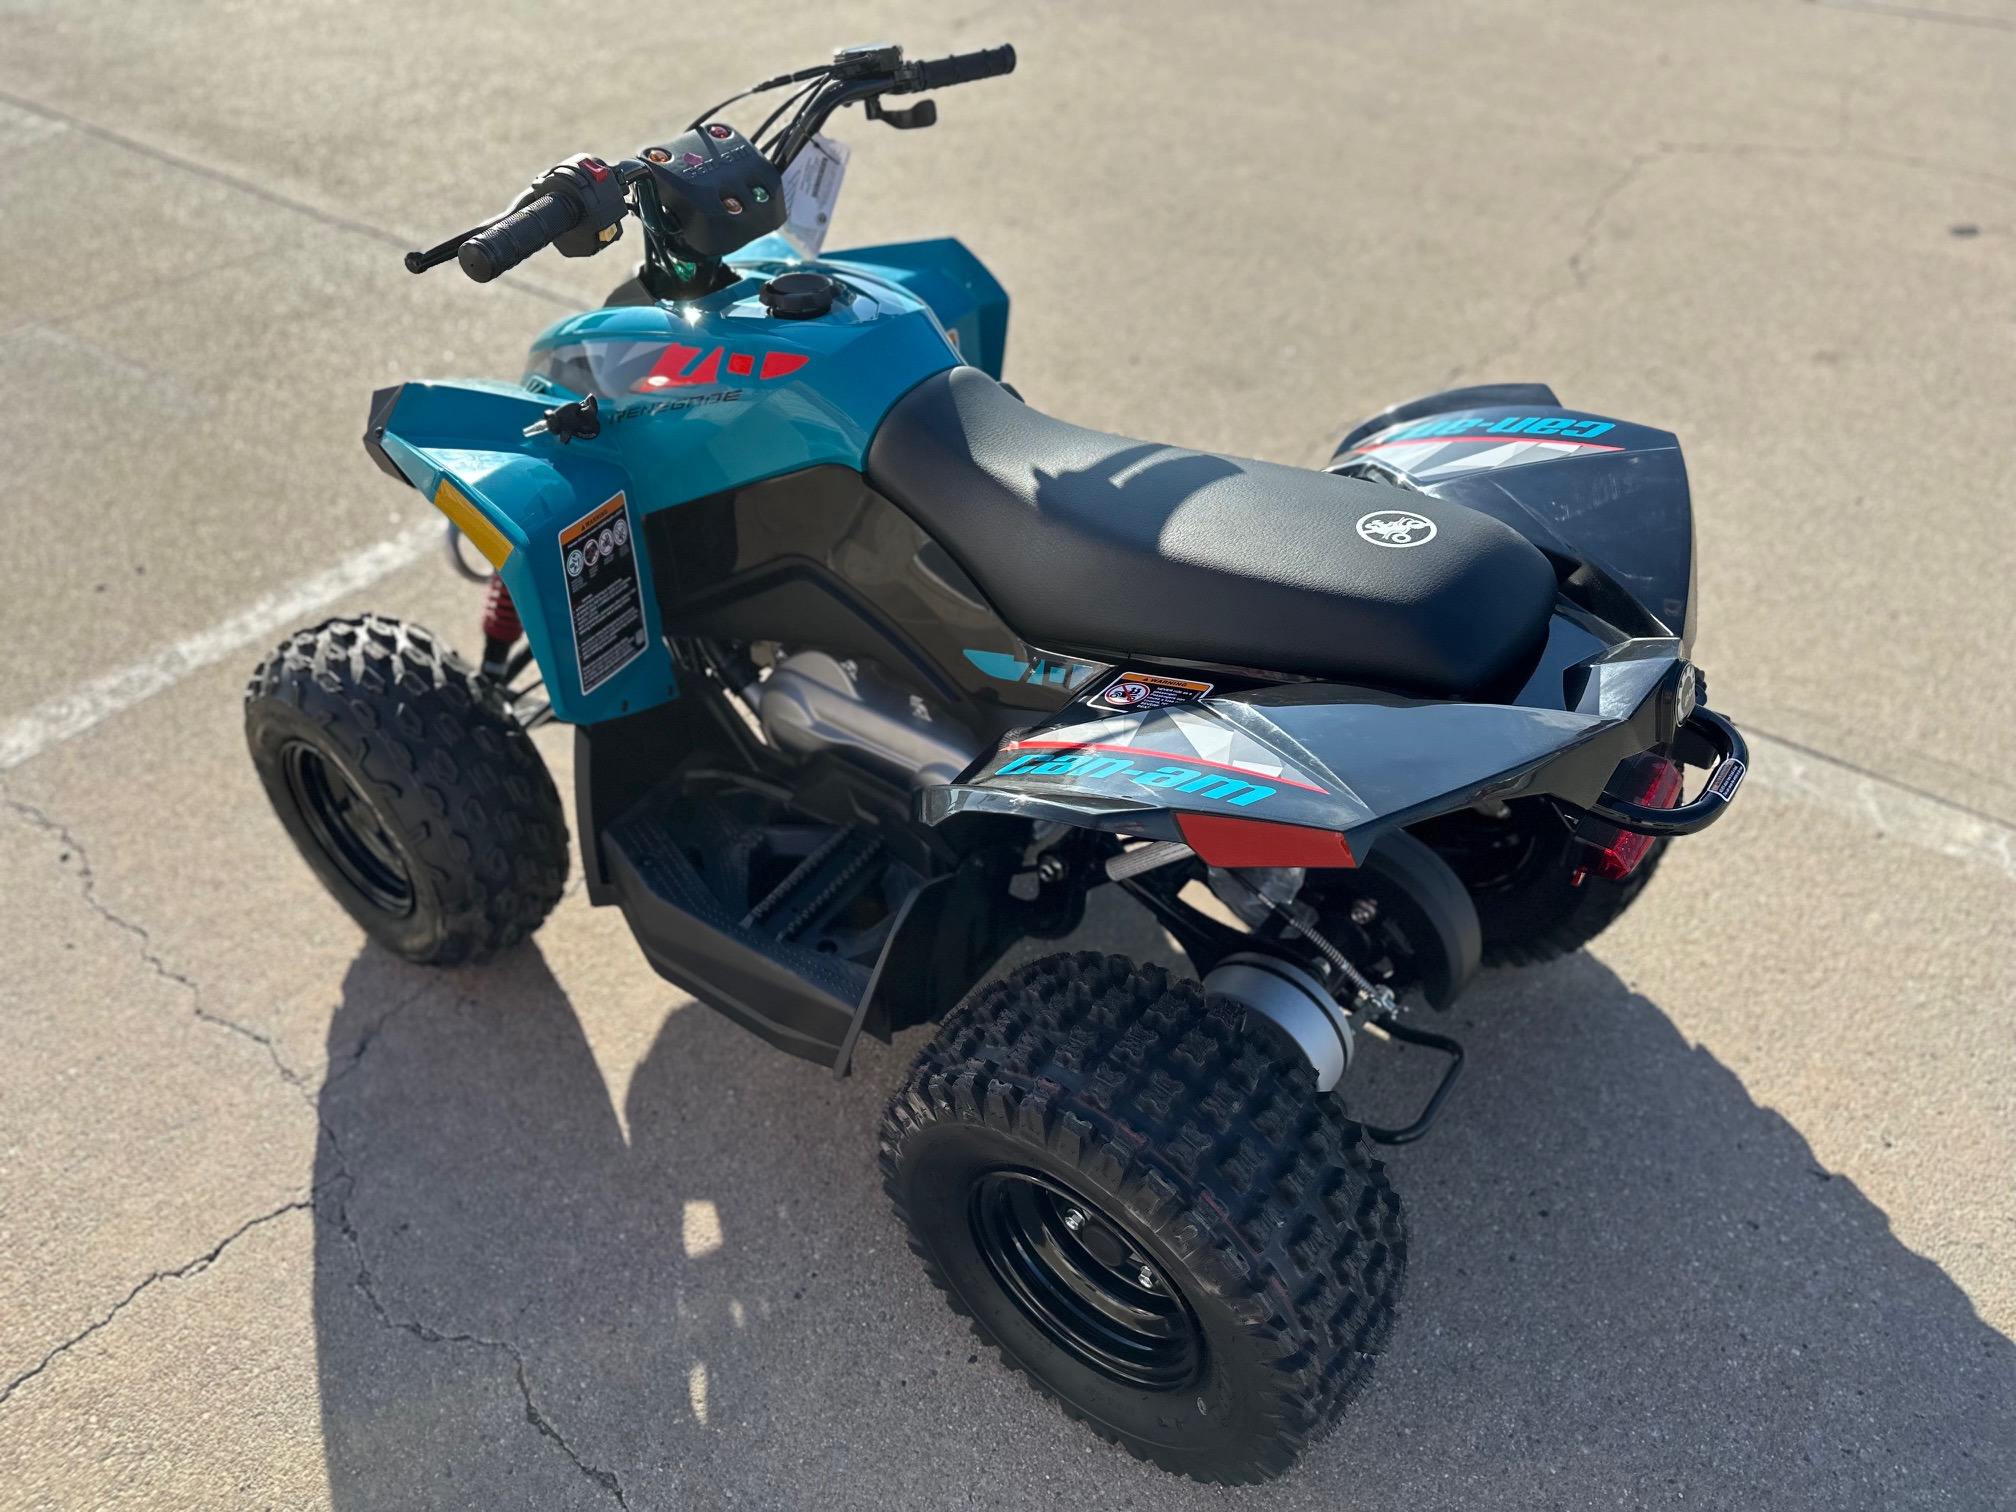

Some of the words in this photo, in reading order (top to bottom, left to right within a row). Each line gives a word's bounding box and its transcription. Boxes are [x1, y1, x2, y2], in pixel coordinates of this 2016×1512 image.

[609, 389, 742, 425] RENEGADE
[1150, 678, 1188, 688] WARNING
[995, 754, 1277, 806] can-am
